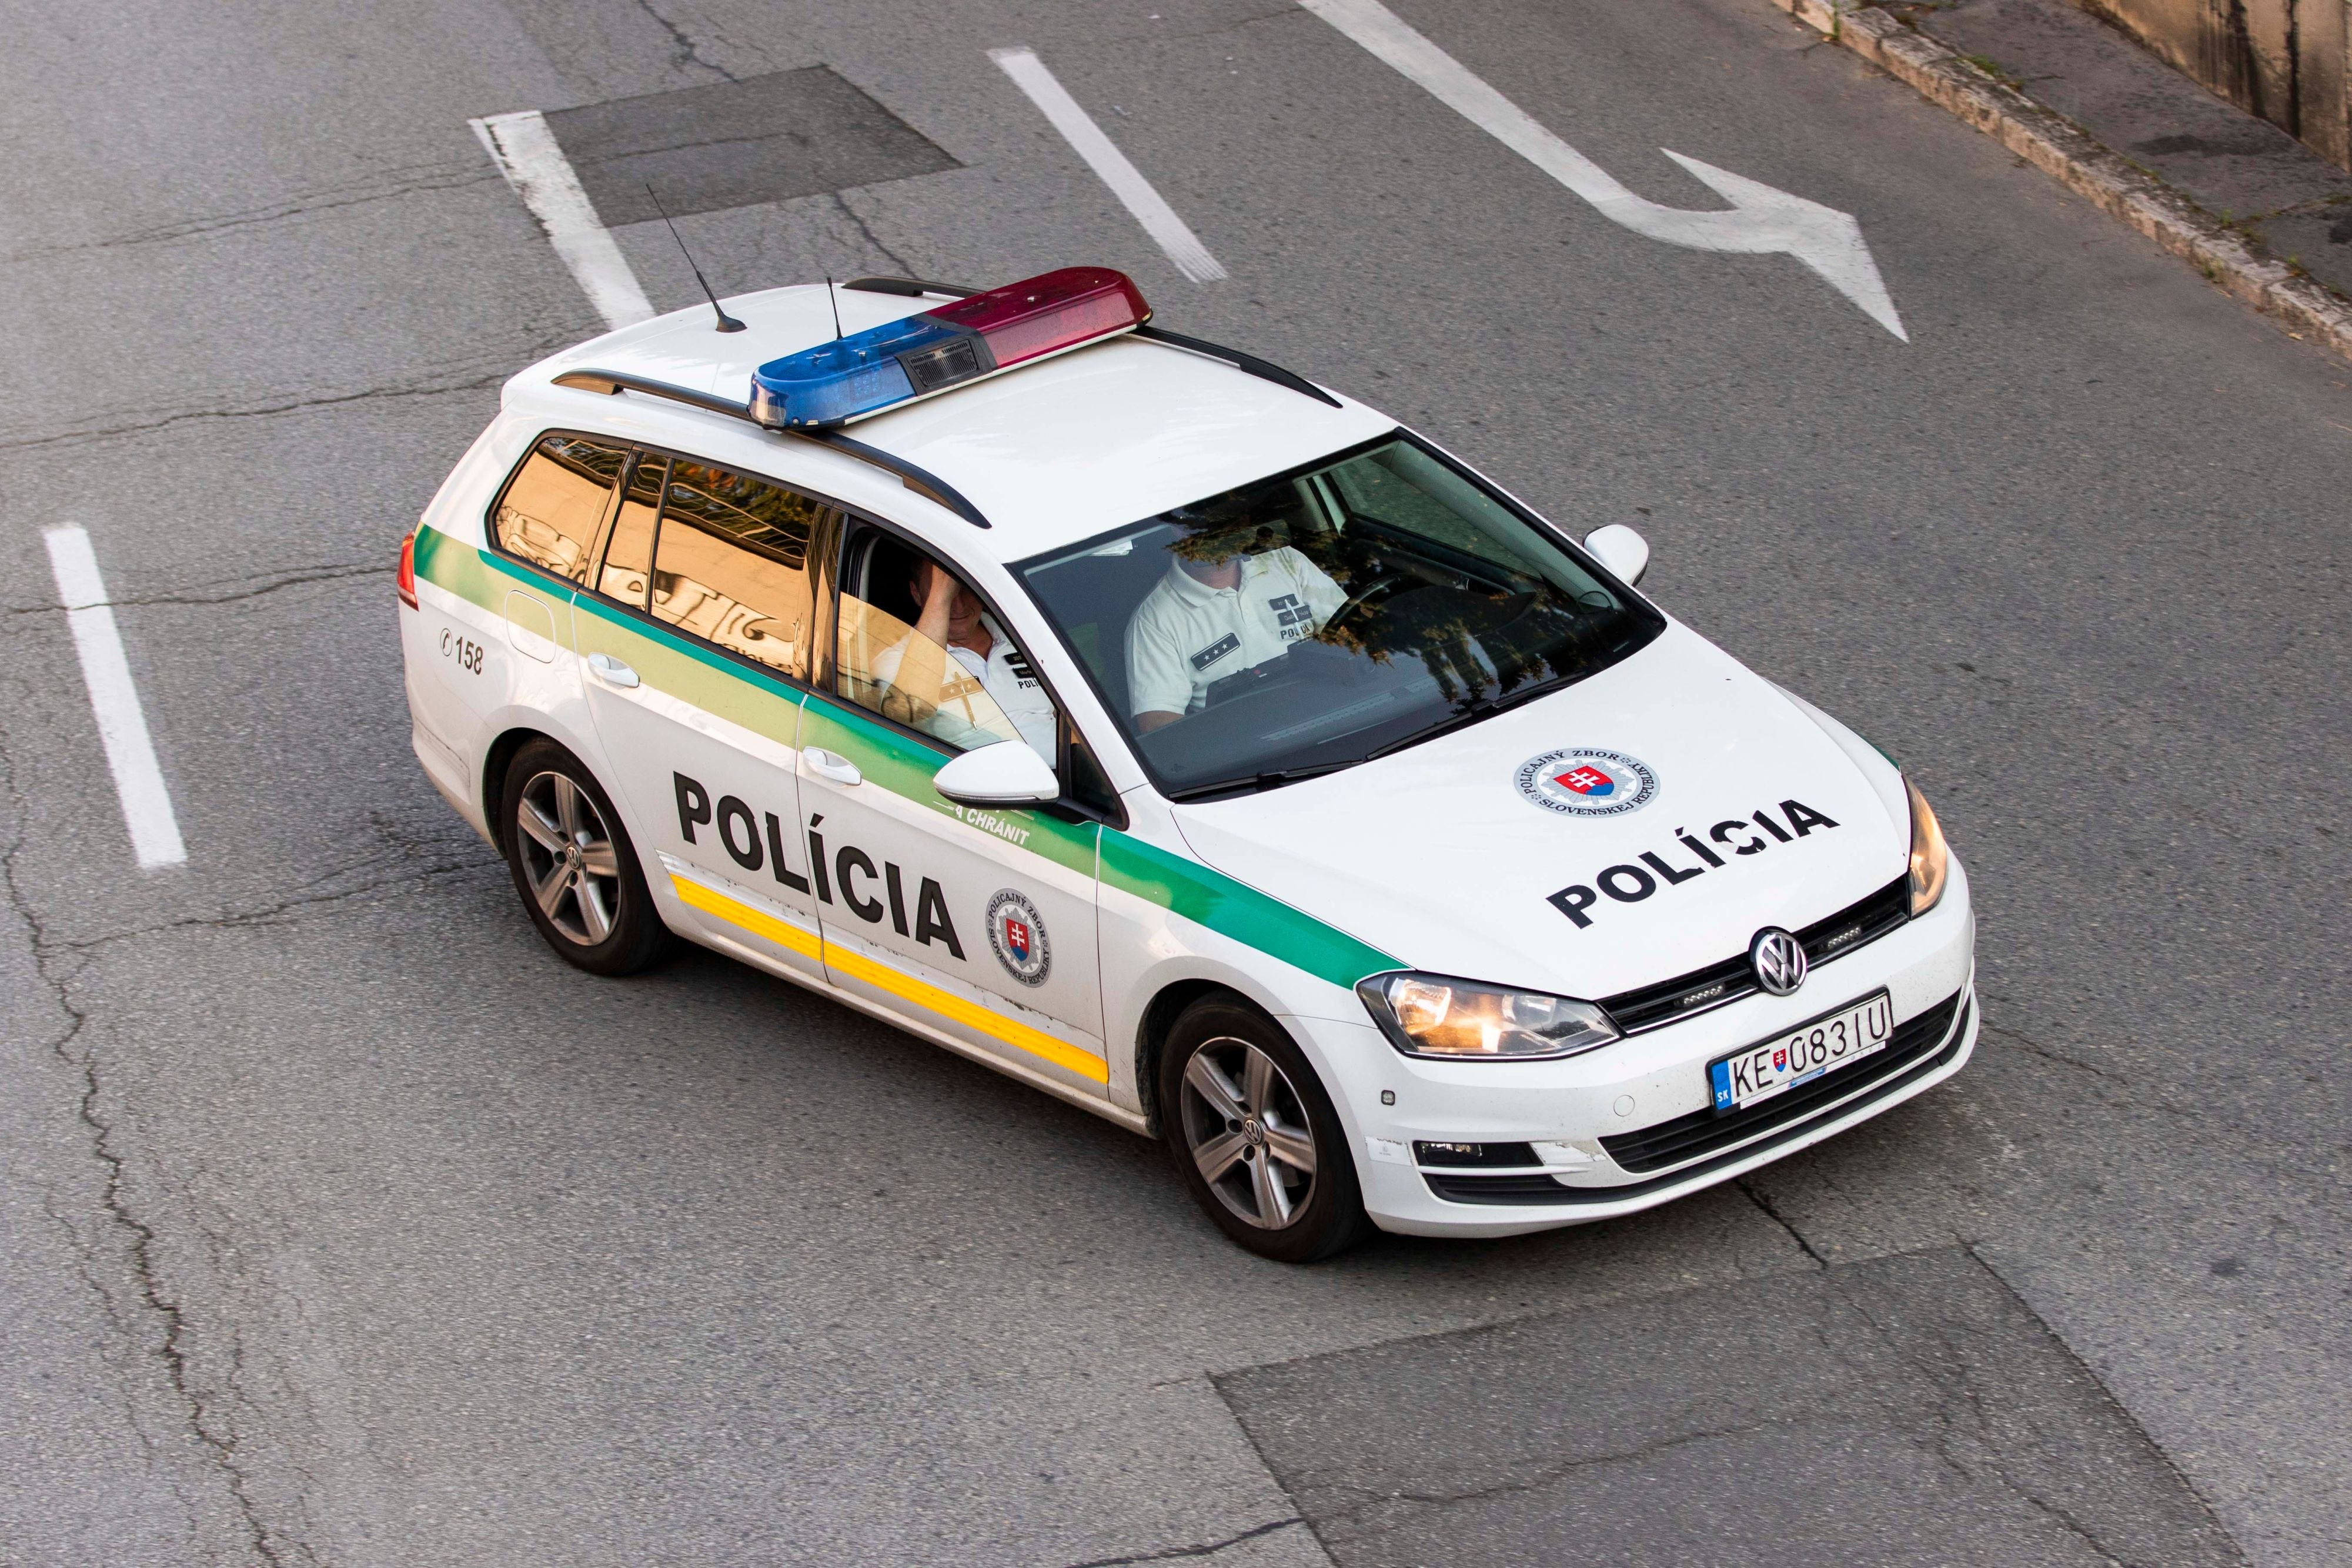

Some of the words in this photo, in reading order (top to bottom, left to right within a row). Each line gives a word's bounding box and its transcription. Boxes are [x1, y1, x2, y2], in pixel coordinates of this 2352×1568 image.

[456, 636, 483, 676] 158
[1017, 677, 1038, 690] POLÍ
[1520, 750, 1565, 794] POLICAJNÝ
[1572, 750, 1619, 761] ZBOR
[1539, 798, 1634, 815] SLOVENSKEJ
[1627, 763, 1654, 805] REPUBLIKY
[673, 771, 967, 962] POLÍCIA
[1545, 799, 1841, 930] POLÍCIA
[988, 892, 1027, 920] POLICAJNÝ
[1027, 907, 1046, 939] ZBOR
[988, 928, 1027, 983] SLOVENSKEJ
[1028, 948, 1050, 985] REPUBLIKY
[1717, 1089, 1729, 1102] SK
[1733, 1048, 1773, 1098] KE
